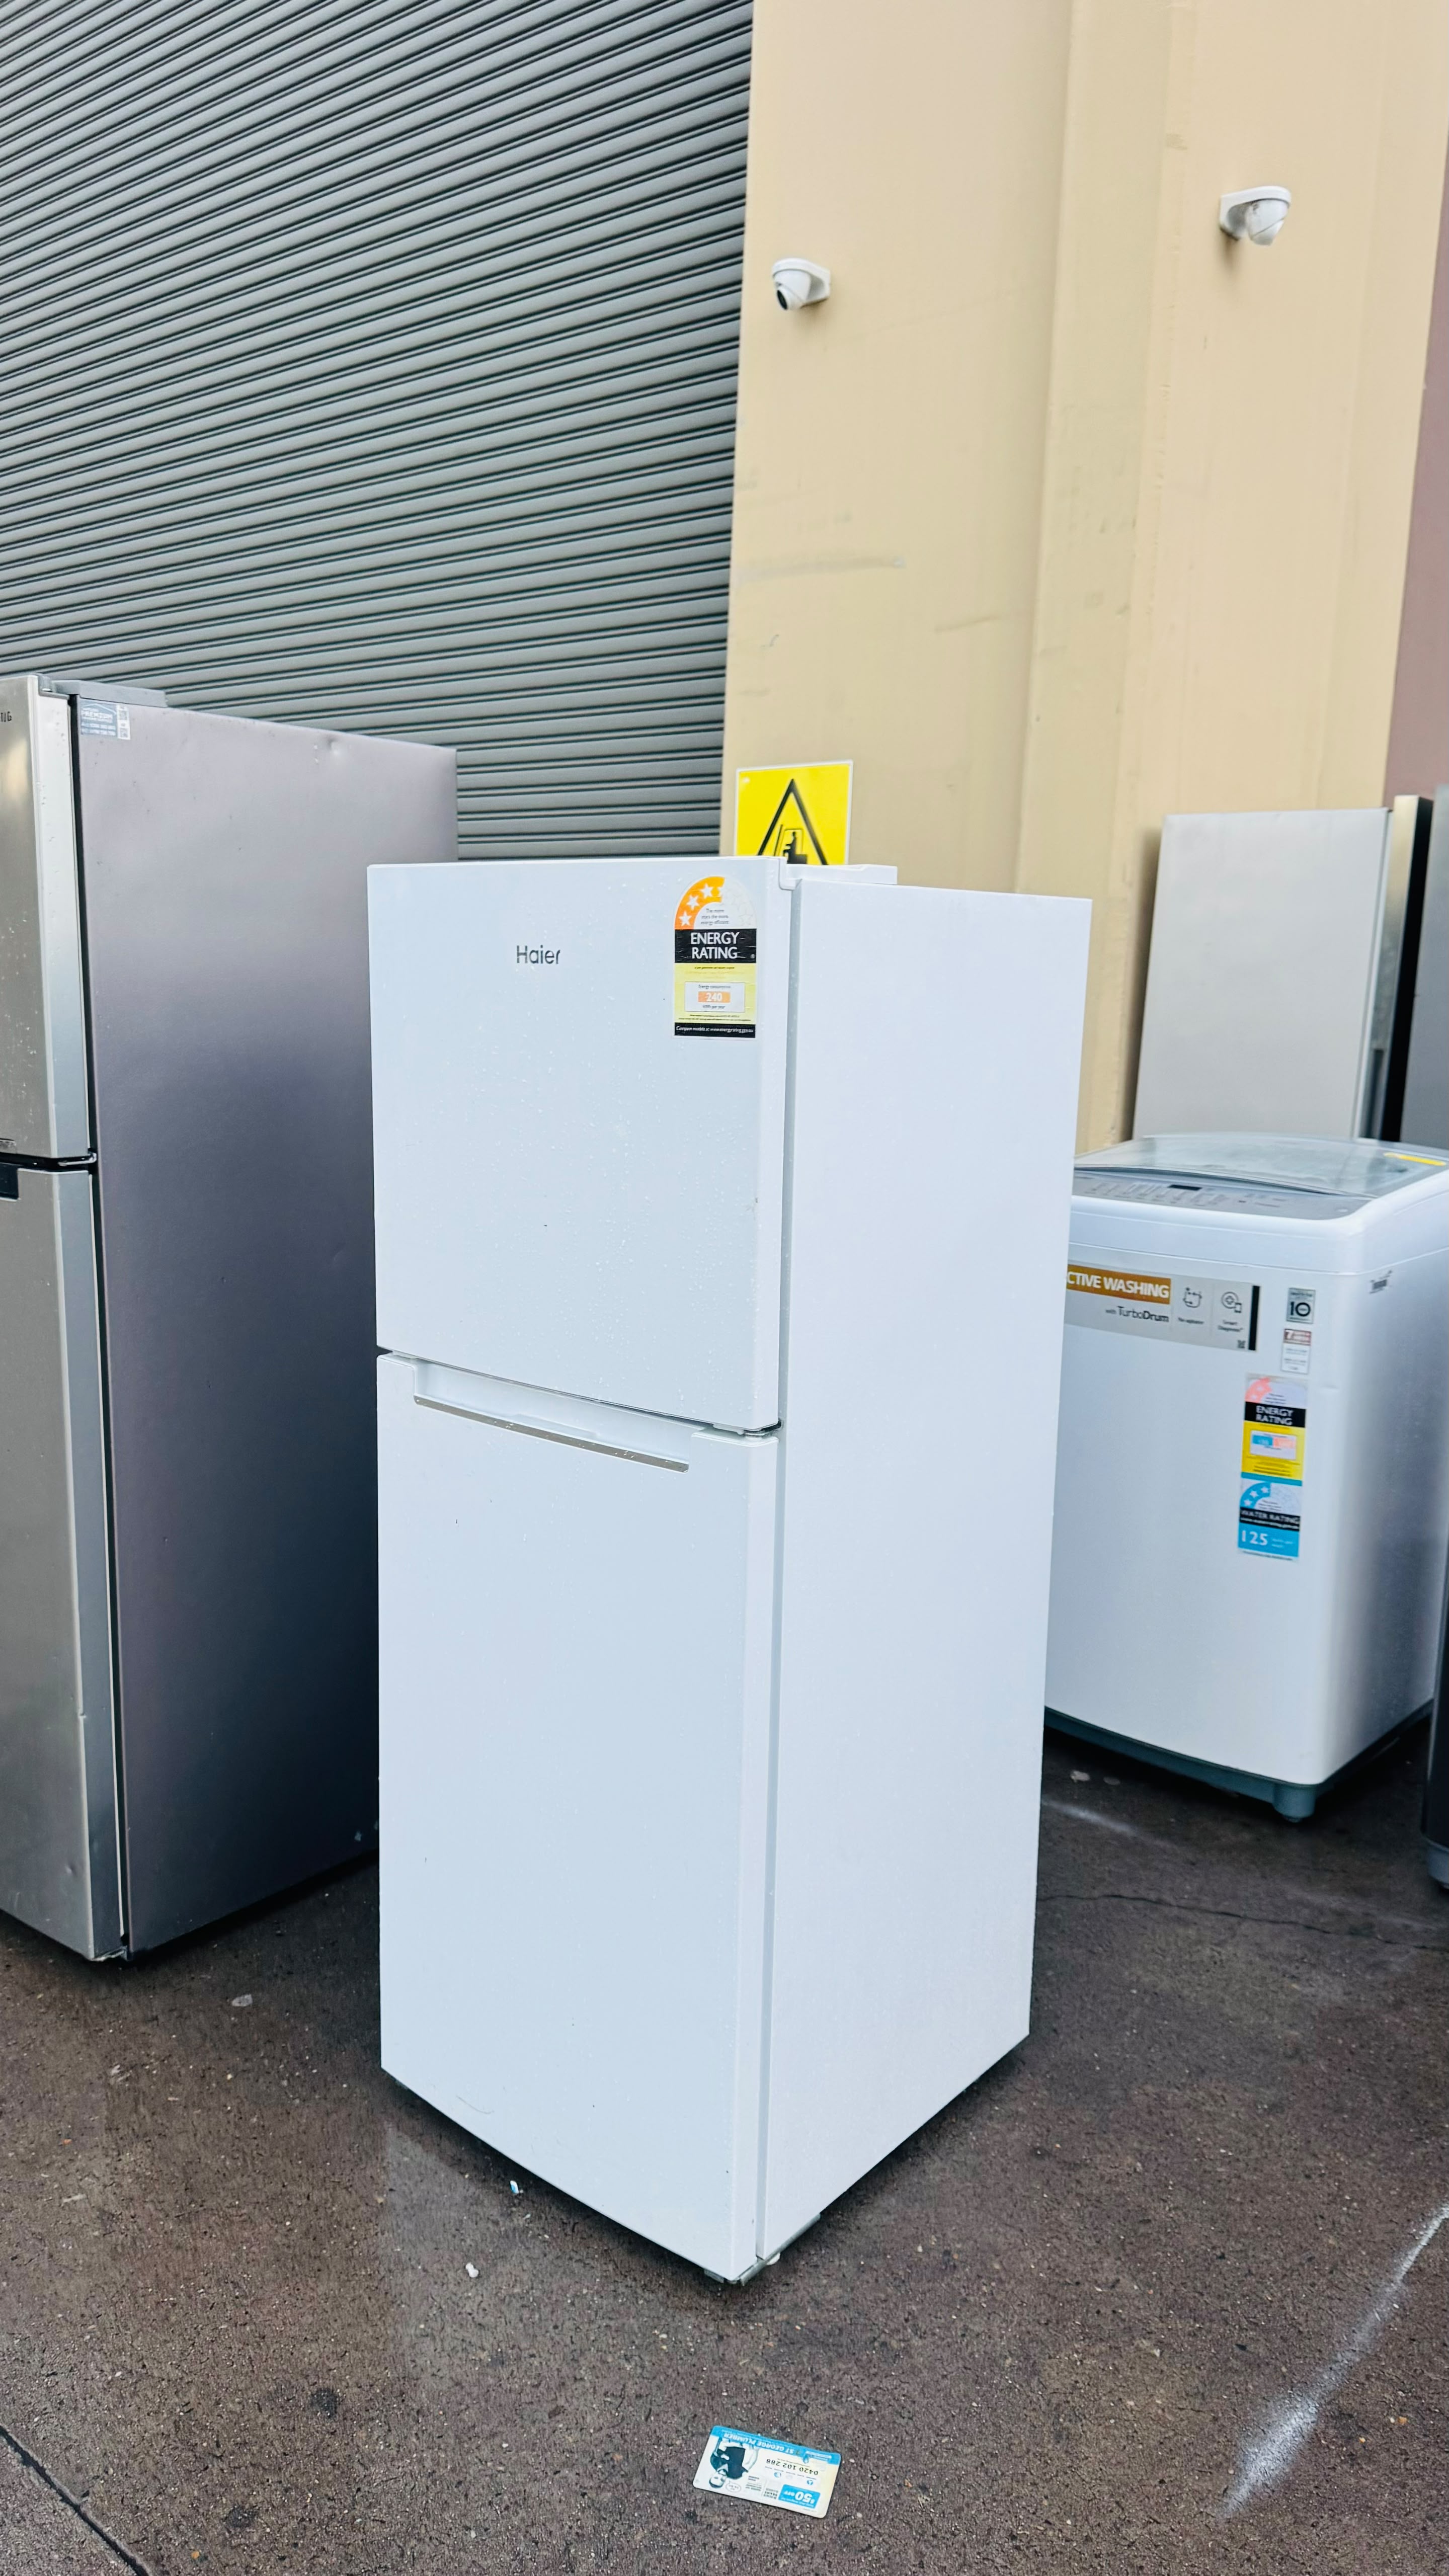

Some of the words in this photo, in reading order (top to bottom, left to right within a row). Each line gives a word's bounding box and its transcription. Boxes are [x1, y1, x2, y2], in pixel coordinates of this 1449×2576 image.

[690, 932, 740, 944] ENERGY
[517, 945, 560, 964] Haier
[692, 946, 738, 959] RATING
[1103, 1276, 1170, 1298] WASHING
[1117, 1306, 1170, 1323] TurboDrum
[1255, 1405, 1294, 1417] ENERGY
[1255, 1413, 1293, 1426] RATING
[1241, 1530, 1268, 1546] 125
[723, 2433, 755, 2445] PLUMBER
[756, 2441, 784, 2451] GEORGE
